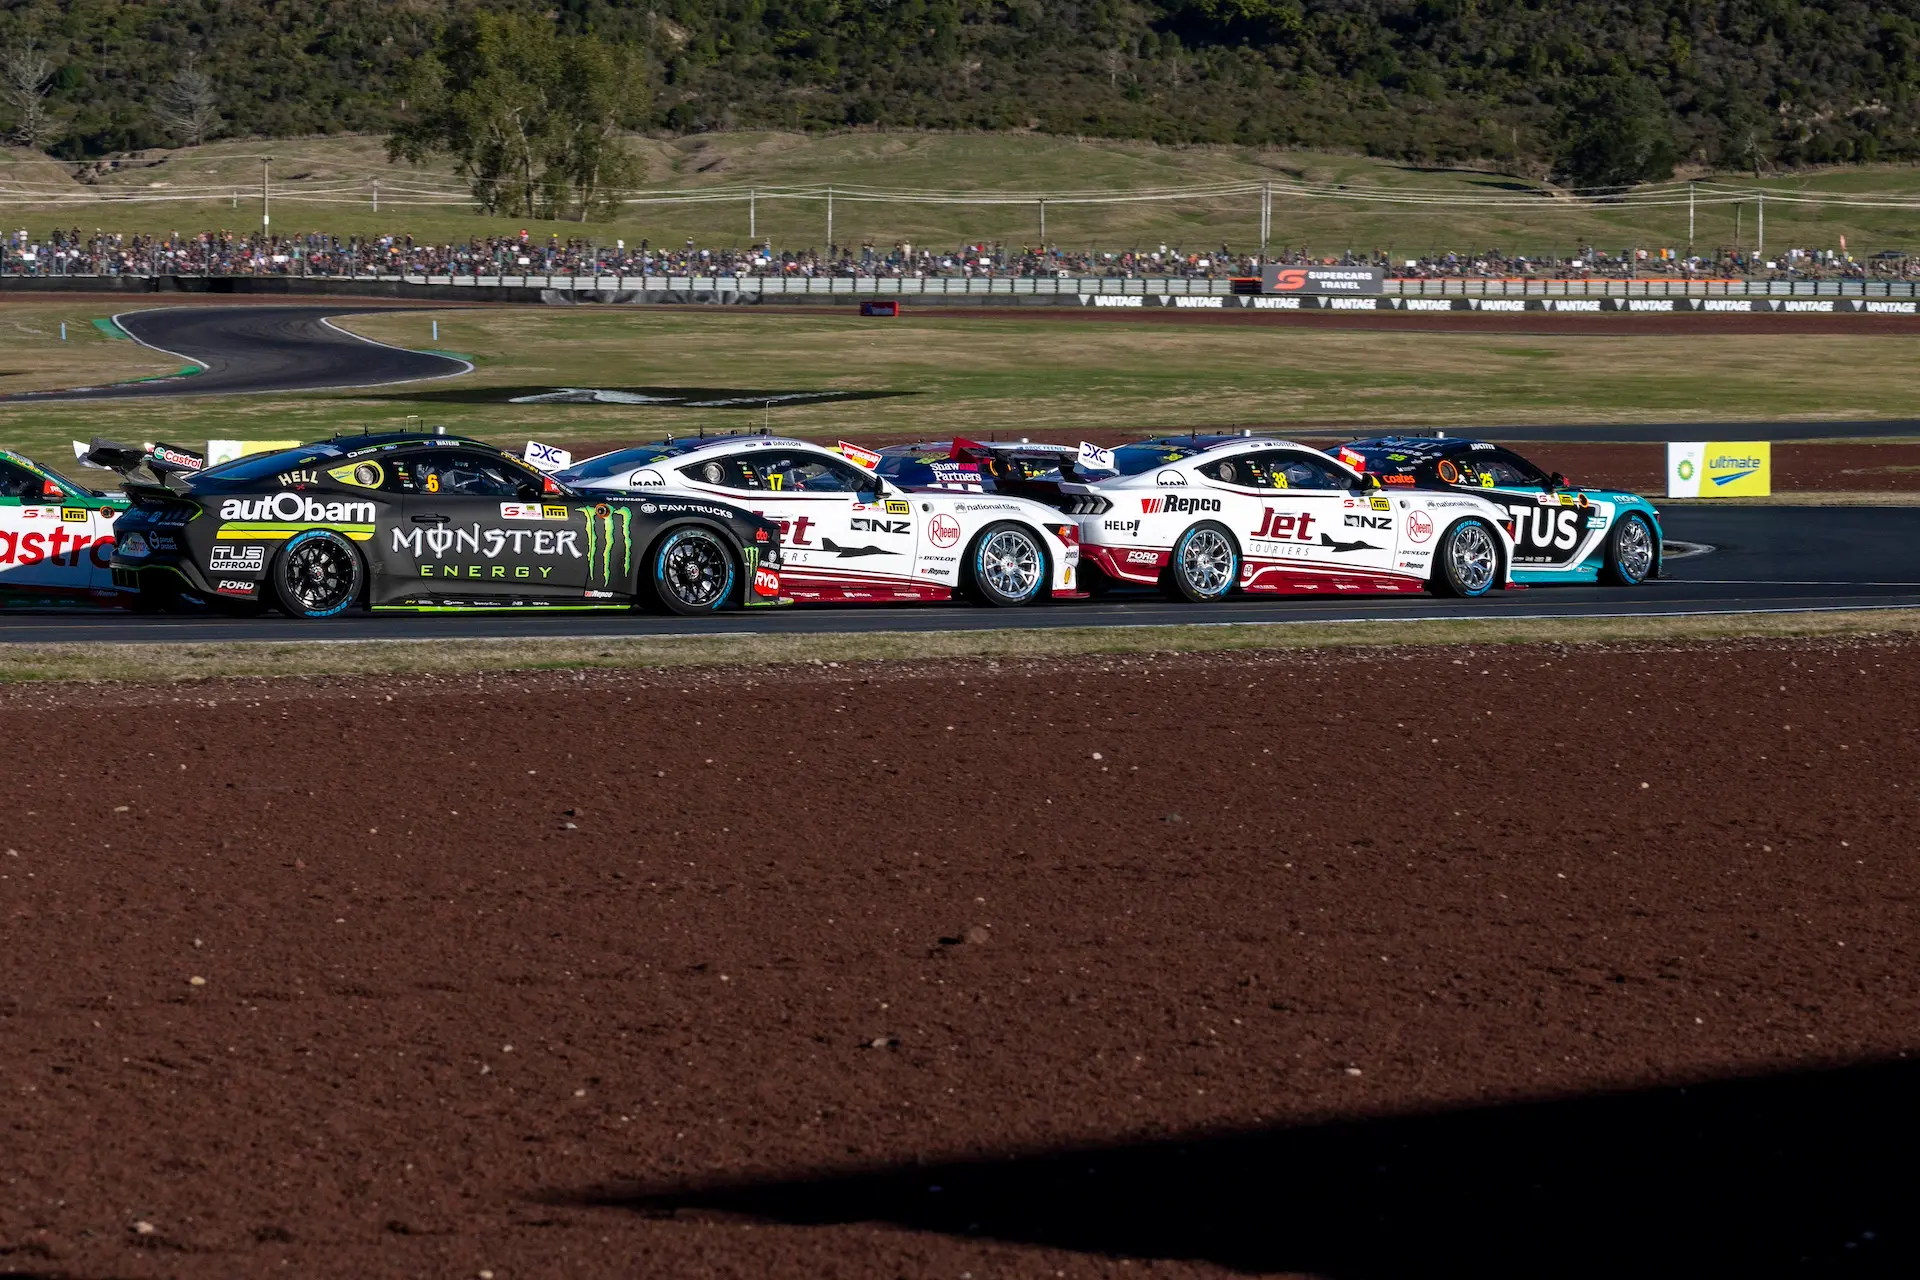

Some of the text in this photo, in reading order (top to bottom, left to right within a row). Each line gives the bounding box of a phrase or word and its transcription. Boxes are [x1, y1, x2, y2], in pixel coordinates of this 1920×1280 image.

[1308, 271, 1372, 281] SUPERCARS
[1320, 281, 1361, 290] TRAVEL
[1094, 295, 1143, 307] VANTAGE
[1175, 296, 1223, 308] VANTAGE
[1254, 297, 1300, 309] VANTAGE
[1331, 298, 1377, 310] VANTAGE
[1406, 299, 1452, 311] VANTAGE
[1480, 299, 1526, 311] VANTAGE
[1555, 300, 1601, 311] VANTAGE
[1629, 300, 1673, 311] VANTAGE
[1704, 300, 1751, 311] VANTAGE
[1785, 300, 1833, 312] VANTAGE
[1866, 301, 1916, 313] VANTAGE
[164, 452, 203, 470] Castrol
[929, 462, 960, 471] Shaw
[1709, 455, 1761, 469] ultimate
[277, 469, 320, 487] HELL
[767, 473, 784, 491] 17
[933, 471, 982, 482] Partners
[1272, 472, 1288, 489] 38
[1479, 472, 1495, 488] 25
[426, 473, 440, 493] 6
[1163, 494, 1221, 515] Repco
[659, 503, 733, 519] FAW TRUCKS
[931, 515, 959, 542] Rheem
[1104, 519, 1140, 537] HELP!
[1250, 507, 1316, 541] Jet
[1457, 519, 1481, 532] DUNLOP
[1587, 517, 1607, 529] 25
[390, 522, 583, 559] MONSTER
[214, 546, 263, 560] TUS
[1128, 551, 1159, 560] FORD
[1249, 543, 1310, 556] COURIERS
[211, 561, 261, 569] OFFROAD
[1404, 561, 1424, 569] Repco
[420, 565, 553, 578] ENERGY
[927, 567, 950, 576] Repco
[218, 580, 255, 590] FORD
[755, 571, 779, 590] RYCO
[592, 590, 613, 598] Repco
